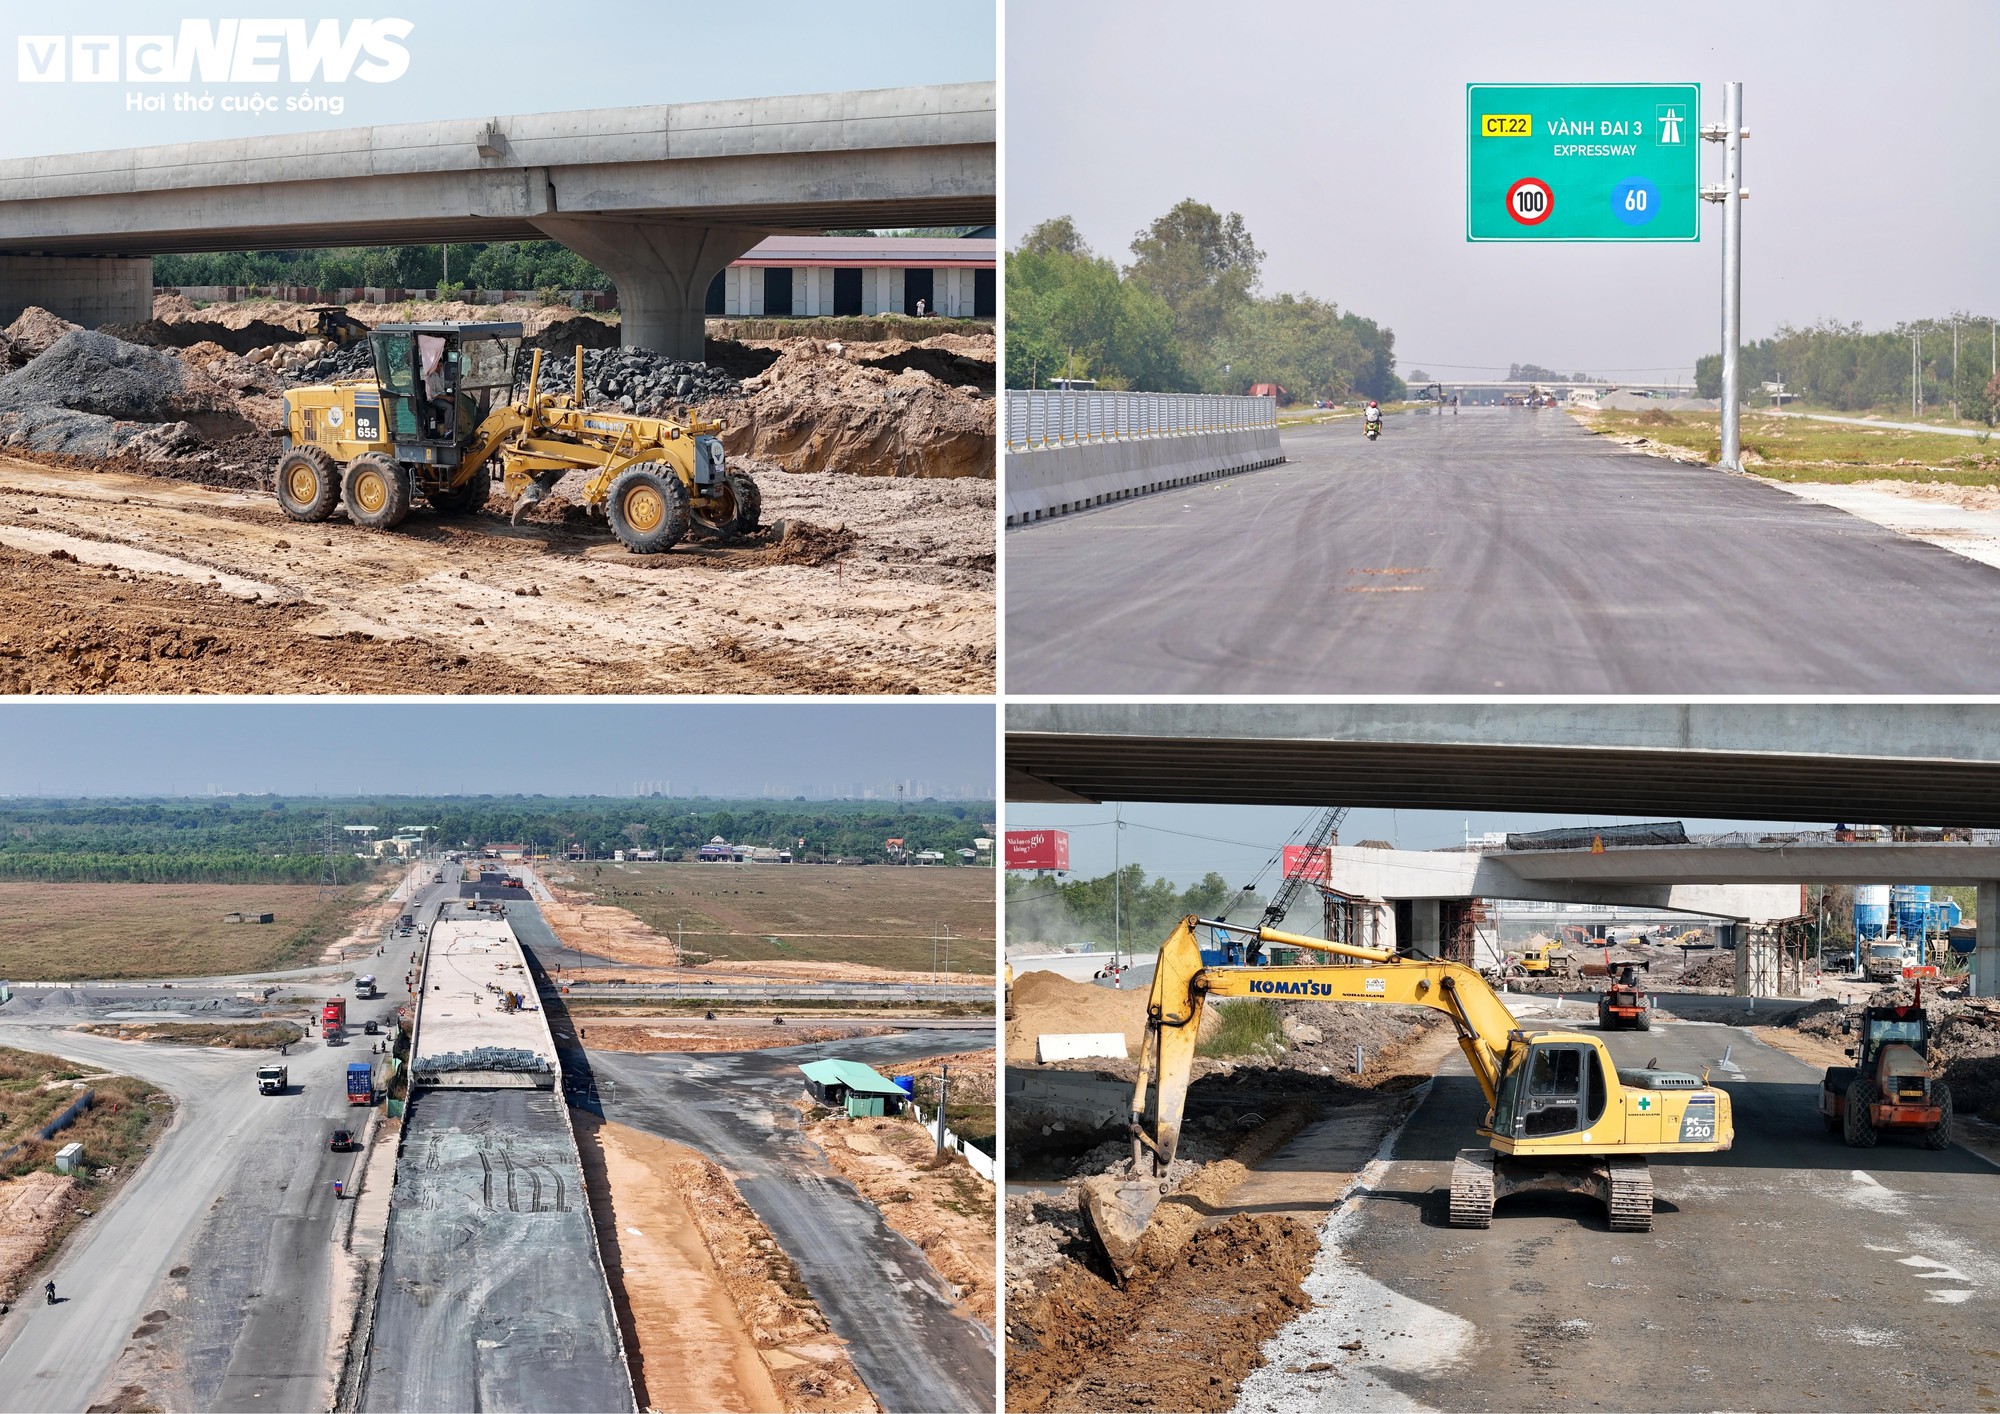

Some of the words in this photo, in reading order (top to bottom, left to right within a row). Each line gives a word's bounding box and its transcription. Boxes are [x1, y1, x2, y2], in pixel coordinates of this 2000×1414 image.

[1486, 118, 1527, 133] CT.22
[1547, 117, 1594, 136] VÀNH
[1601, 120, 1629, 136] ĐAI
[1633, 121, 1643, 136] 3
[1553, 145, 1637, 157] EXPRESSWAY
[1516, 191, 1544, 213] 100
[1624, 190, 1647, 211] 60
[357, 418, 370, 427] GD
[357, 427, 378, 438] 655
[1031, 833, 1045, 848] gió
[1249, 979, 1332, 996] KOMATSU
[1686, 1117, 1699, 1126] PC
[1685, 1126, 1711, 1137] 220
